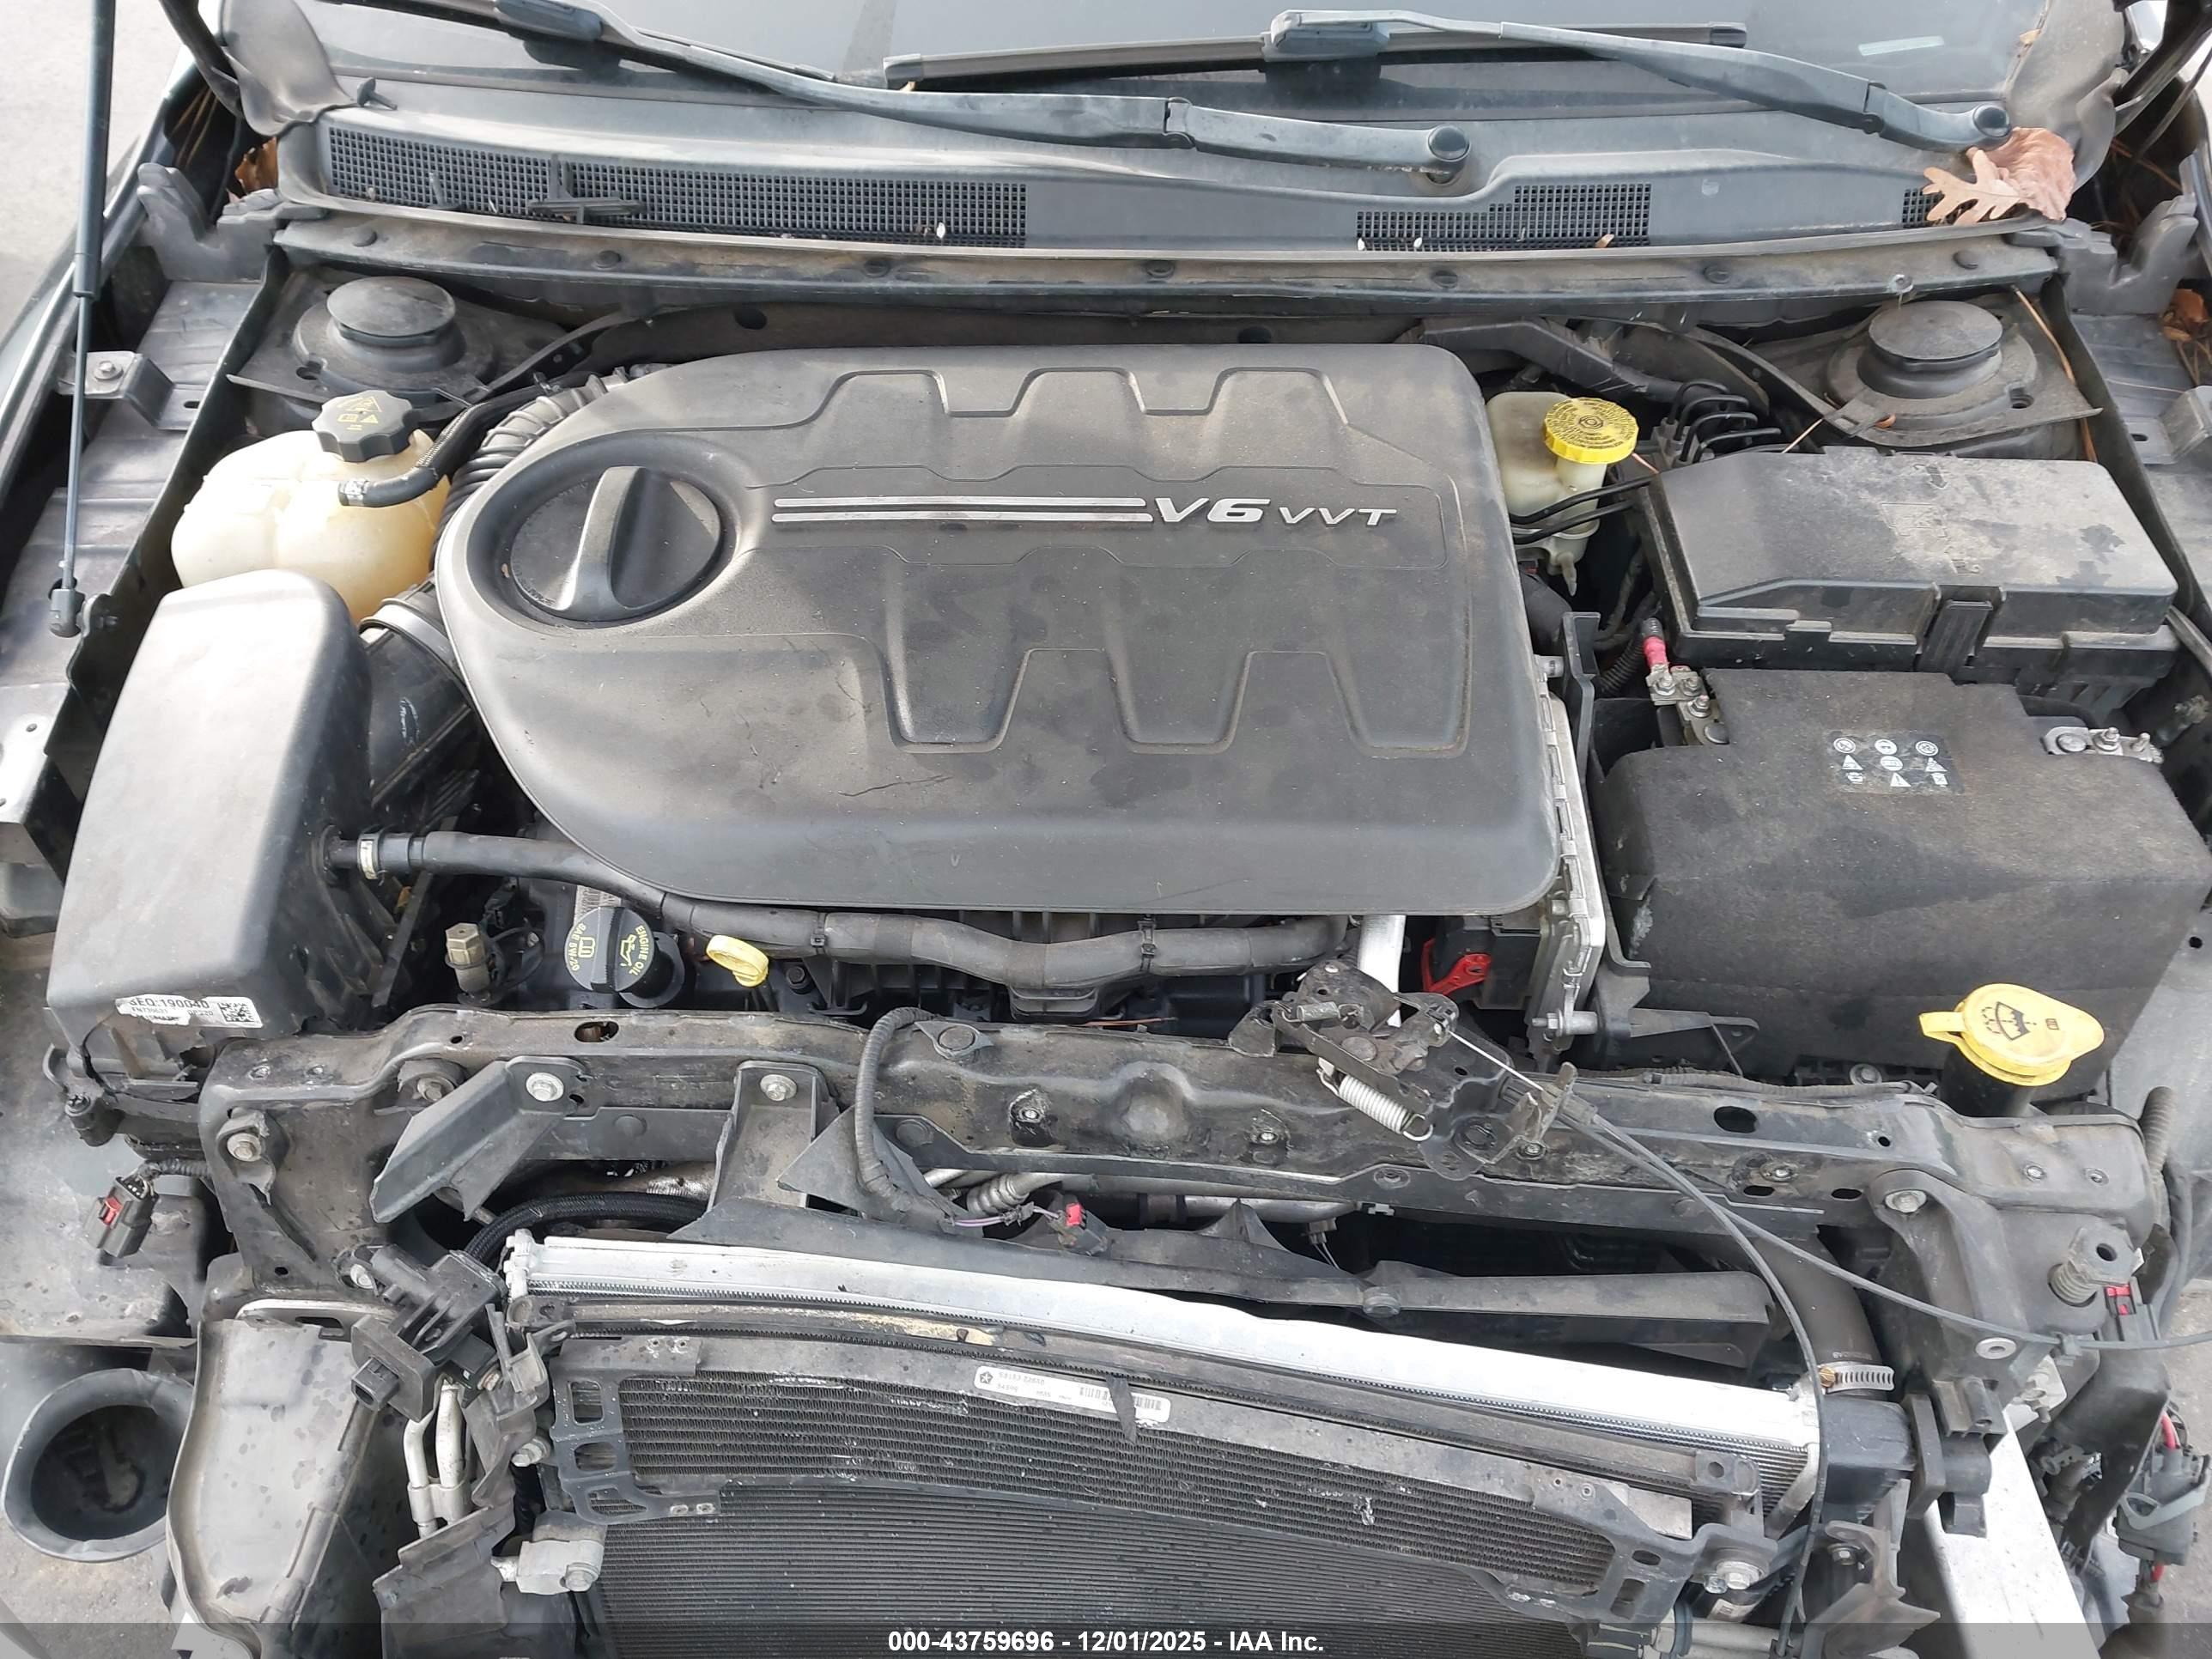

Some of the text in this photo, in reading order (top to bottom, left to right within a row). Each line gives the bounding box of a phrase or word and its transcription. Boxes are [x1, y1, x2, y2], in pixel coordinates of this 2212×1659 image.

[1155, 497, 1398, 526] V6 VVT
[568, 923, 586, 971] SAE 5W-20
[629, 925, 649, 975] ENGINE OIL
